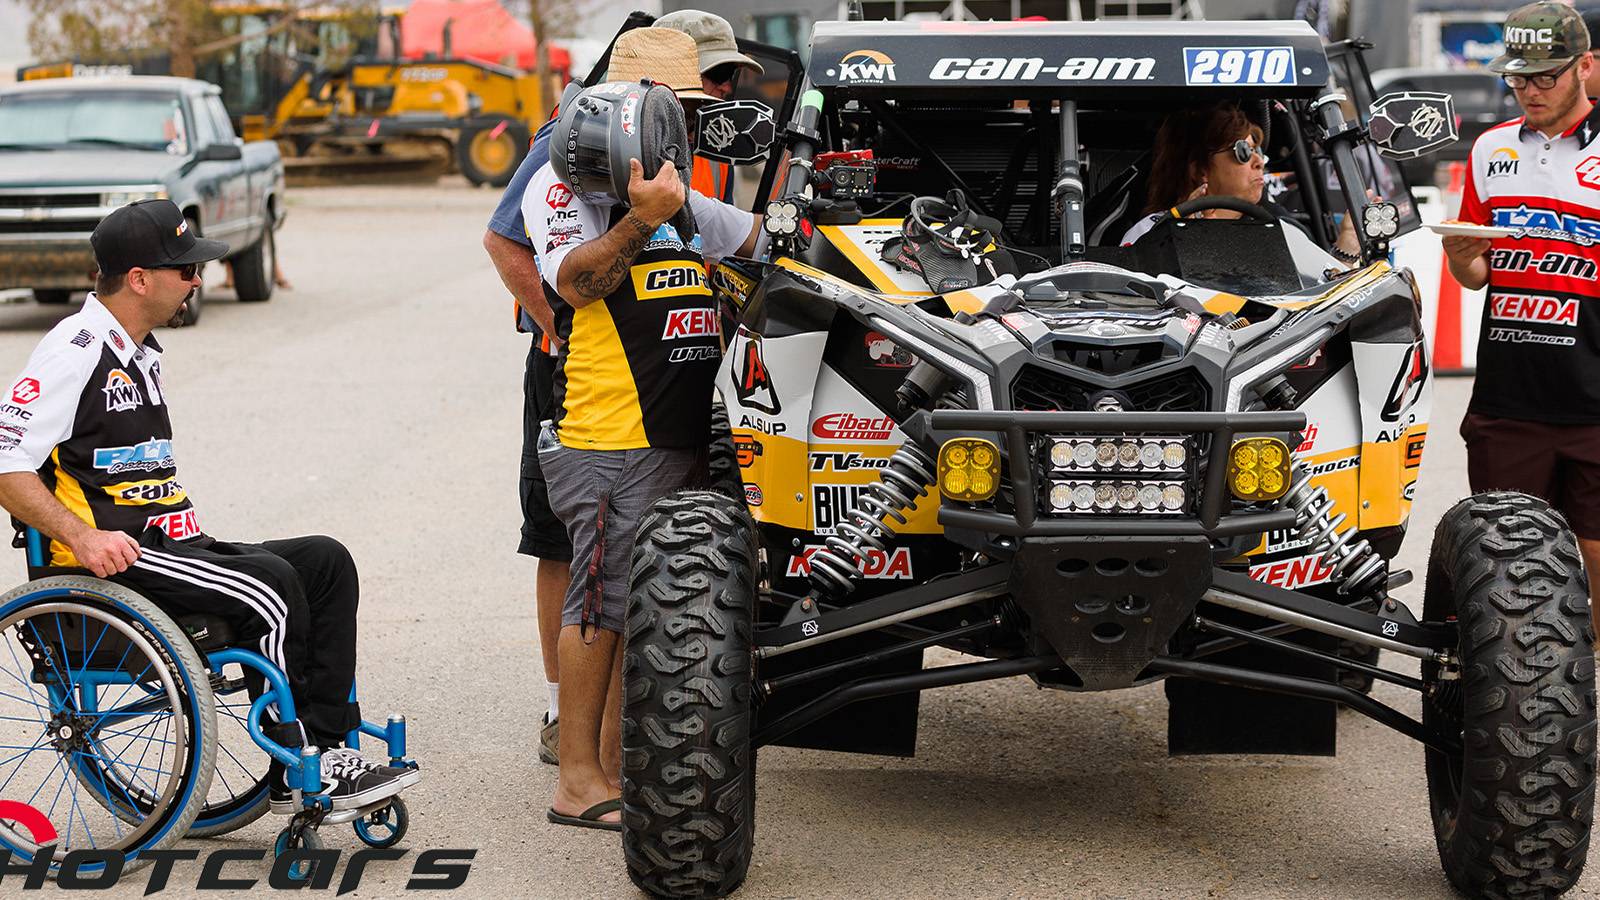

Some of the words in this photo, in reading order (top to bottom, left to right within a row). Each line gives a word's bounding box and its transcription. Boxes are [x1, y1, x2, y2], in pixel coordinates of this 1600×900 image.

[838, 63, 896, 81] KWI
[928, 57, 1154, 80] can-am
[1190, 49, 1291, 84] 2910
[1487, 160, 1520, 178] KWI
[1492, 206, 1600, 242] LAIS
[1490, 250, 1598, 281] an-am
[740, 415, 787, 436] ALSUP
